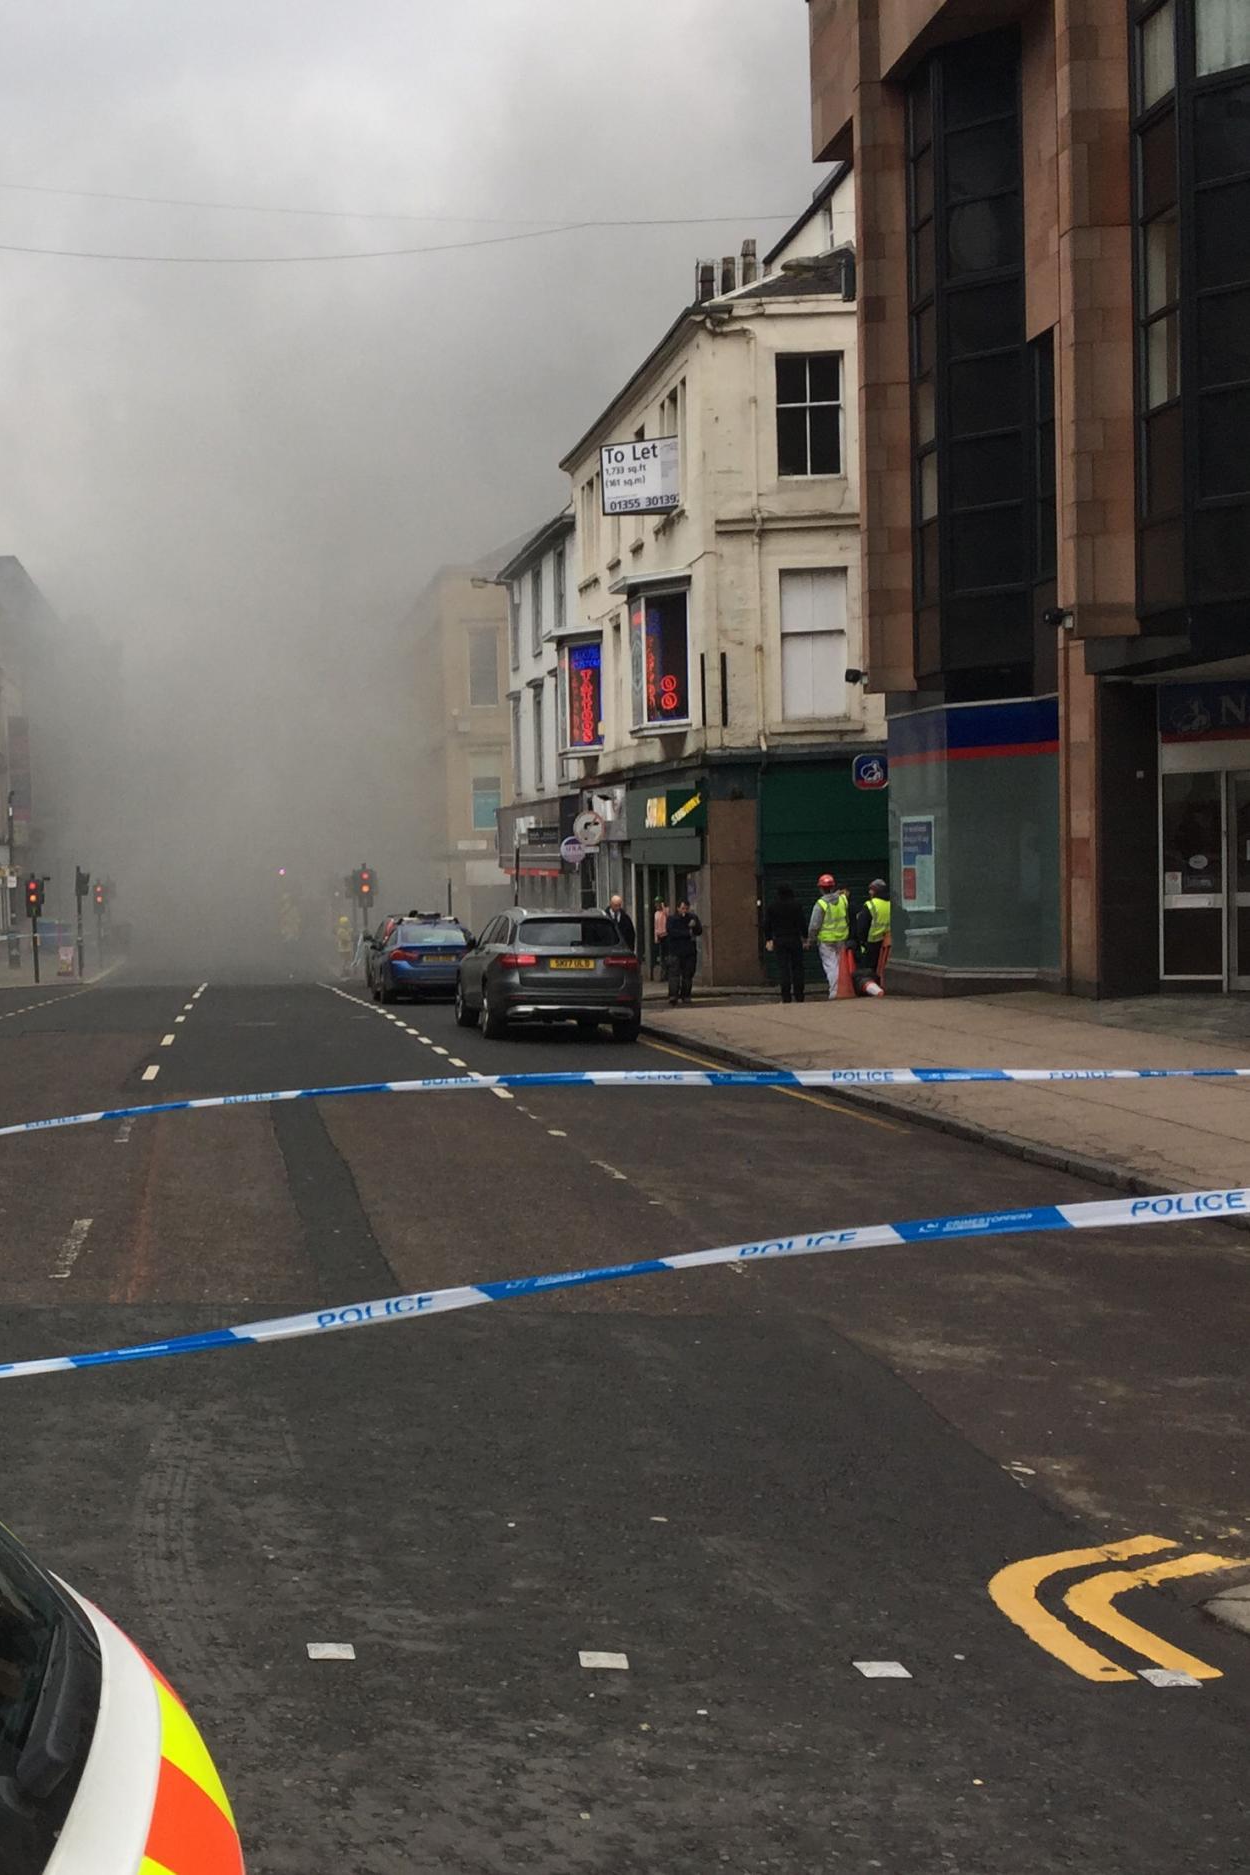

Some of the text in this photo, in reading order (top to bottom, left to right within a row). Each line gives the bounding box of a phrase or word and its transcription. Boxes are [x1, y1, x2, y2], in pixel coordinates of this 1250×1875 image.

[604, 443, 658, 464] To Let
[605, 466, 625, 475] 1,733
[610, 498, 641, 511] 01355
[832, 1071, 895, 1082] POLICE
[1131, 1191, 1246, 1217] POLICE
[317, 1295, 433, 1329] POLICE
